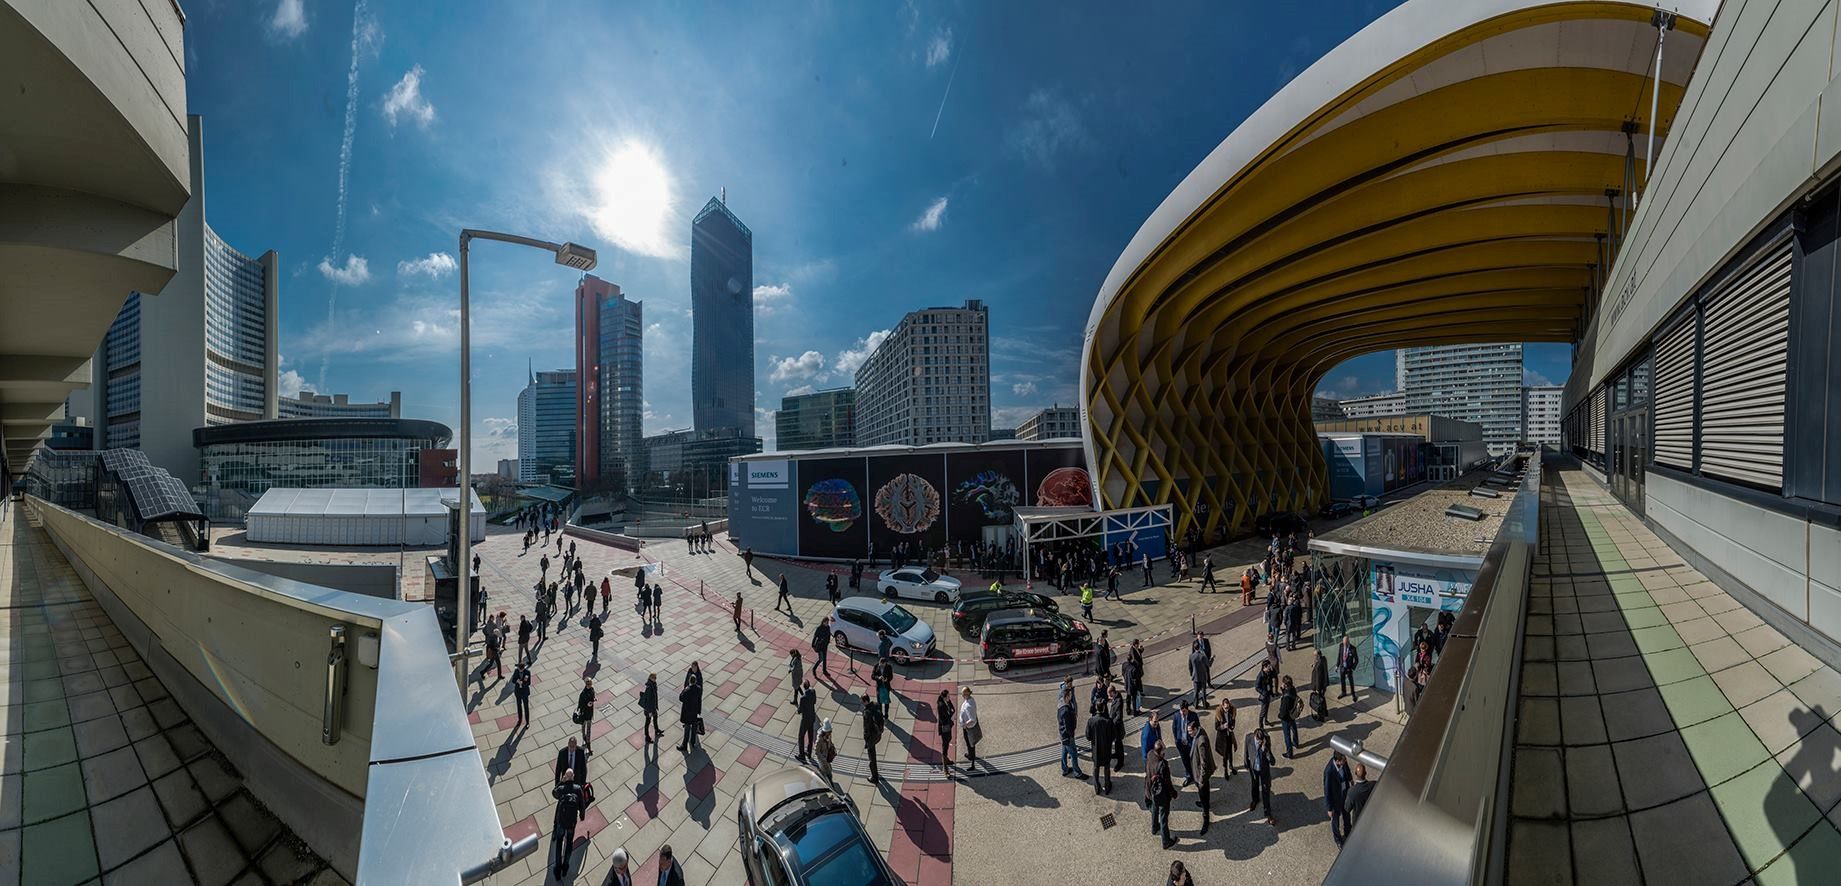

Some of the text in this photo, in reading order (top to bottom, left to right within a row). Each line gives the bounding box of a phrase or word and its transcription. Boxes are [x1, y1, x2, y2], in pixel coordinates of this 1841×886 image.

[751, 471, 778, 479] SIEMENS
[751, 496, 777, 504] Welcome
[1398, 582, 1434, 595] JUSHA
